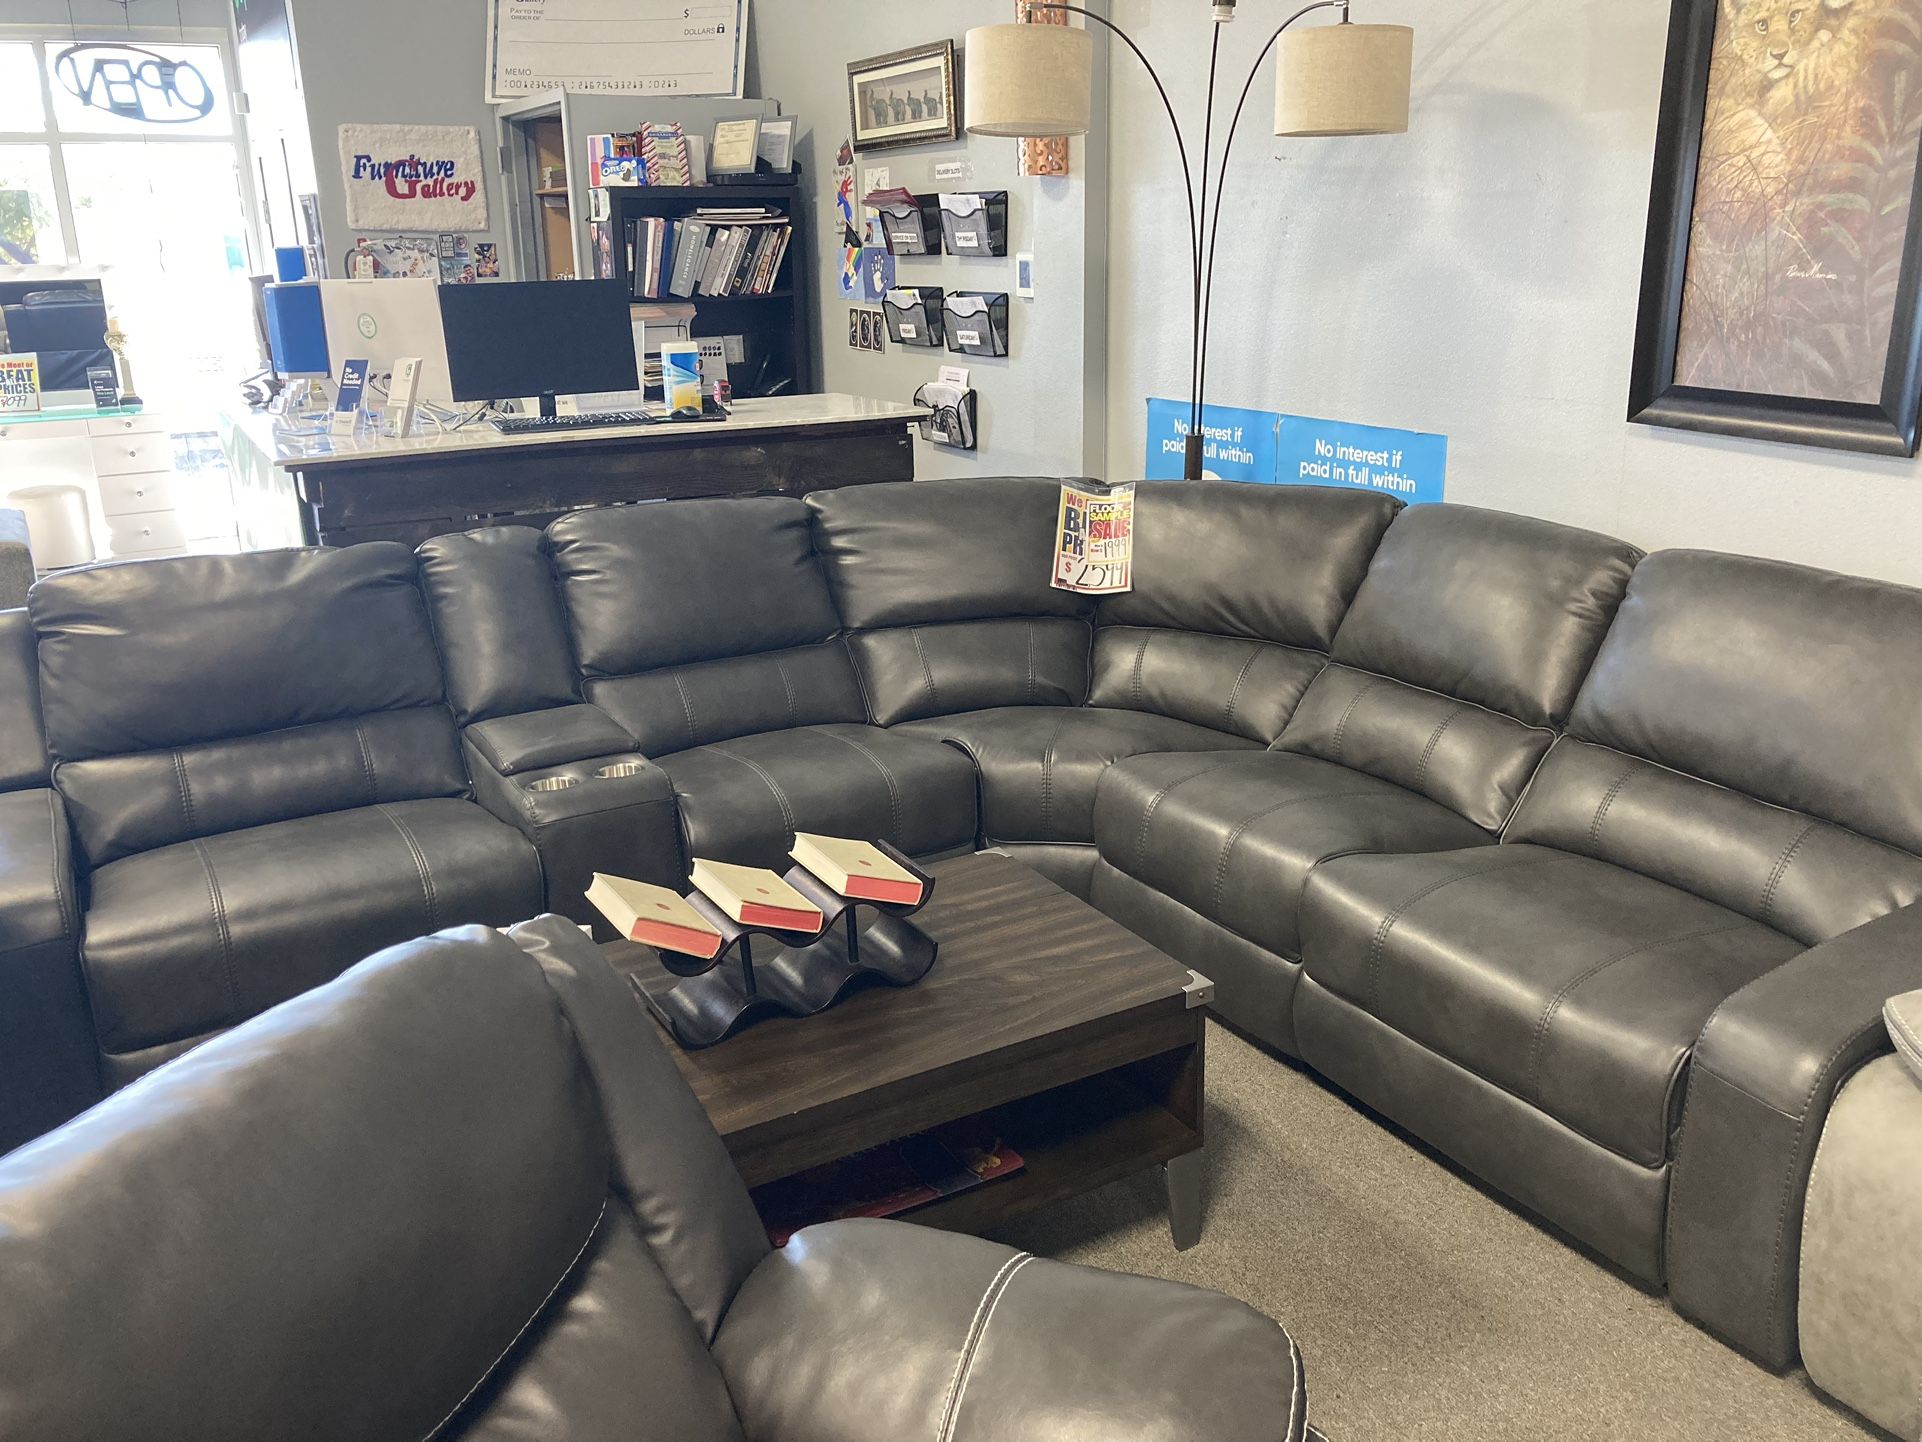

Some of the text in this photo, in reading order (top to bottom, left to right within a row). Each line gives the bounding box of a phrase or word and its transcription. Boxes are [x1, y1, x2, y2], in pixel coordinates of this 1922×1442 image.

[683, 8, 690, 19] $
[684, 27, 716, 36] DOLLARS
[505, 68, 532, 76] MEMO
[352, 154, 455, 181] Furniture
[385, 159, 476, 202] Gallery
[1174, 419, 1189, 436] No
[1234, 427, 1243, 443] if
[1162, 438, 1186, 454] paid
[1219, 446, 1254, 465] within
[1315, 438, 1403, 469] No interest if
[1299, 460, 1416, 494] paid in full within
[1066, 492, 1083, 508] We
[1089, 511, 1130, 521] SAMPLE
[1092, 520, 1128, 540] SALE
[1065, 561, 1072, 573] $
